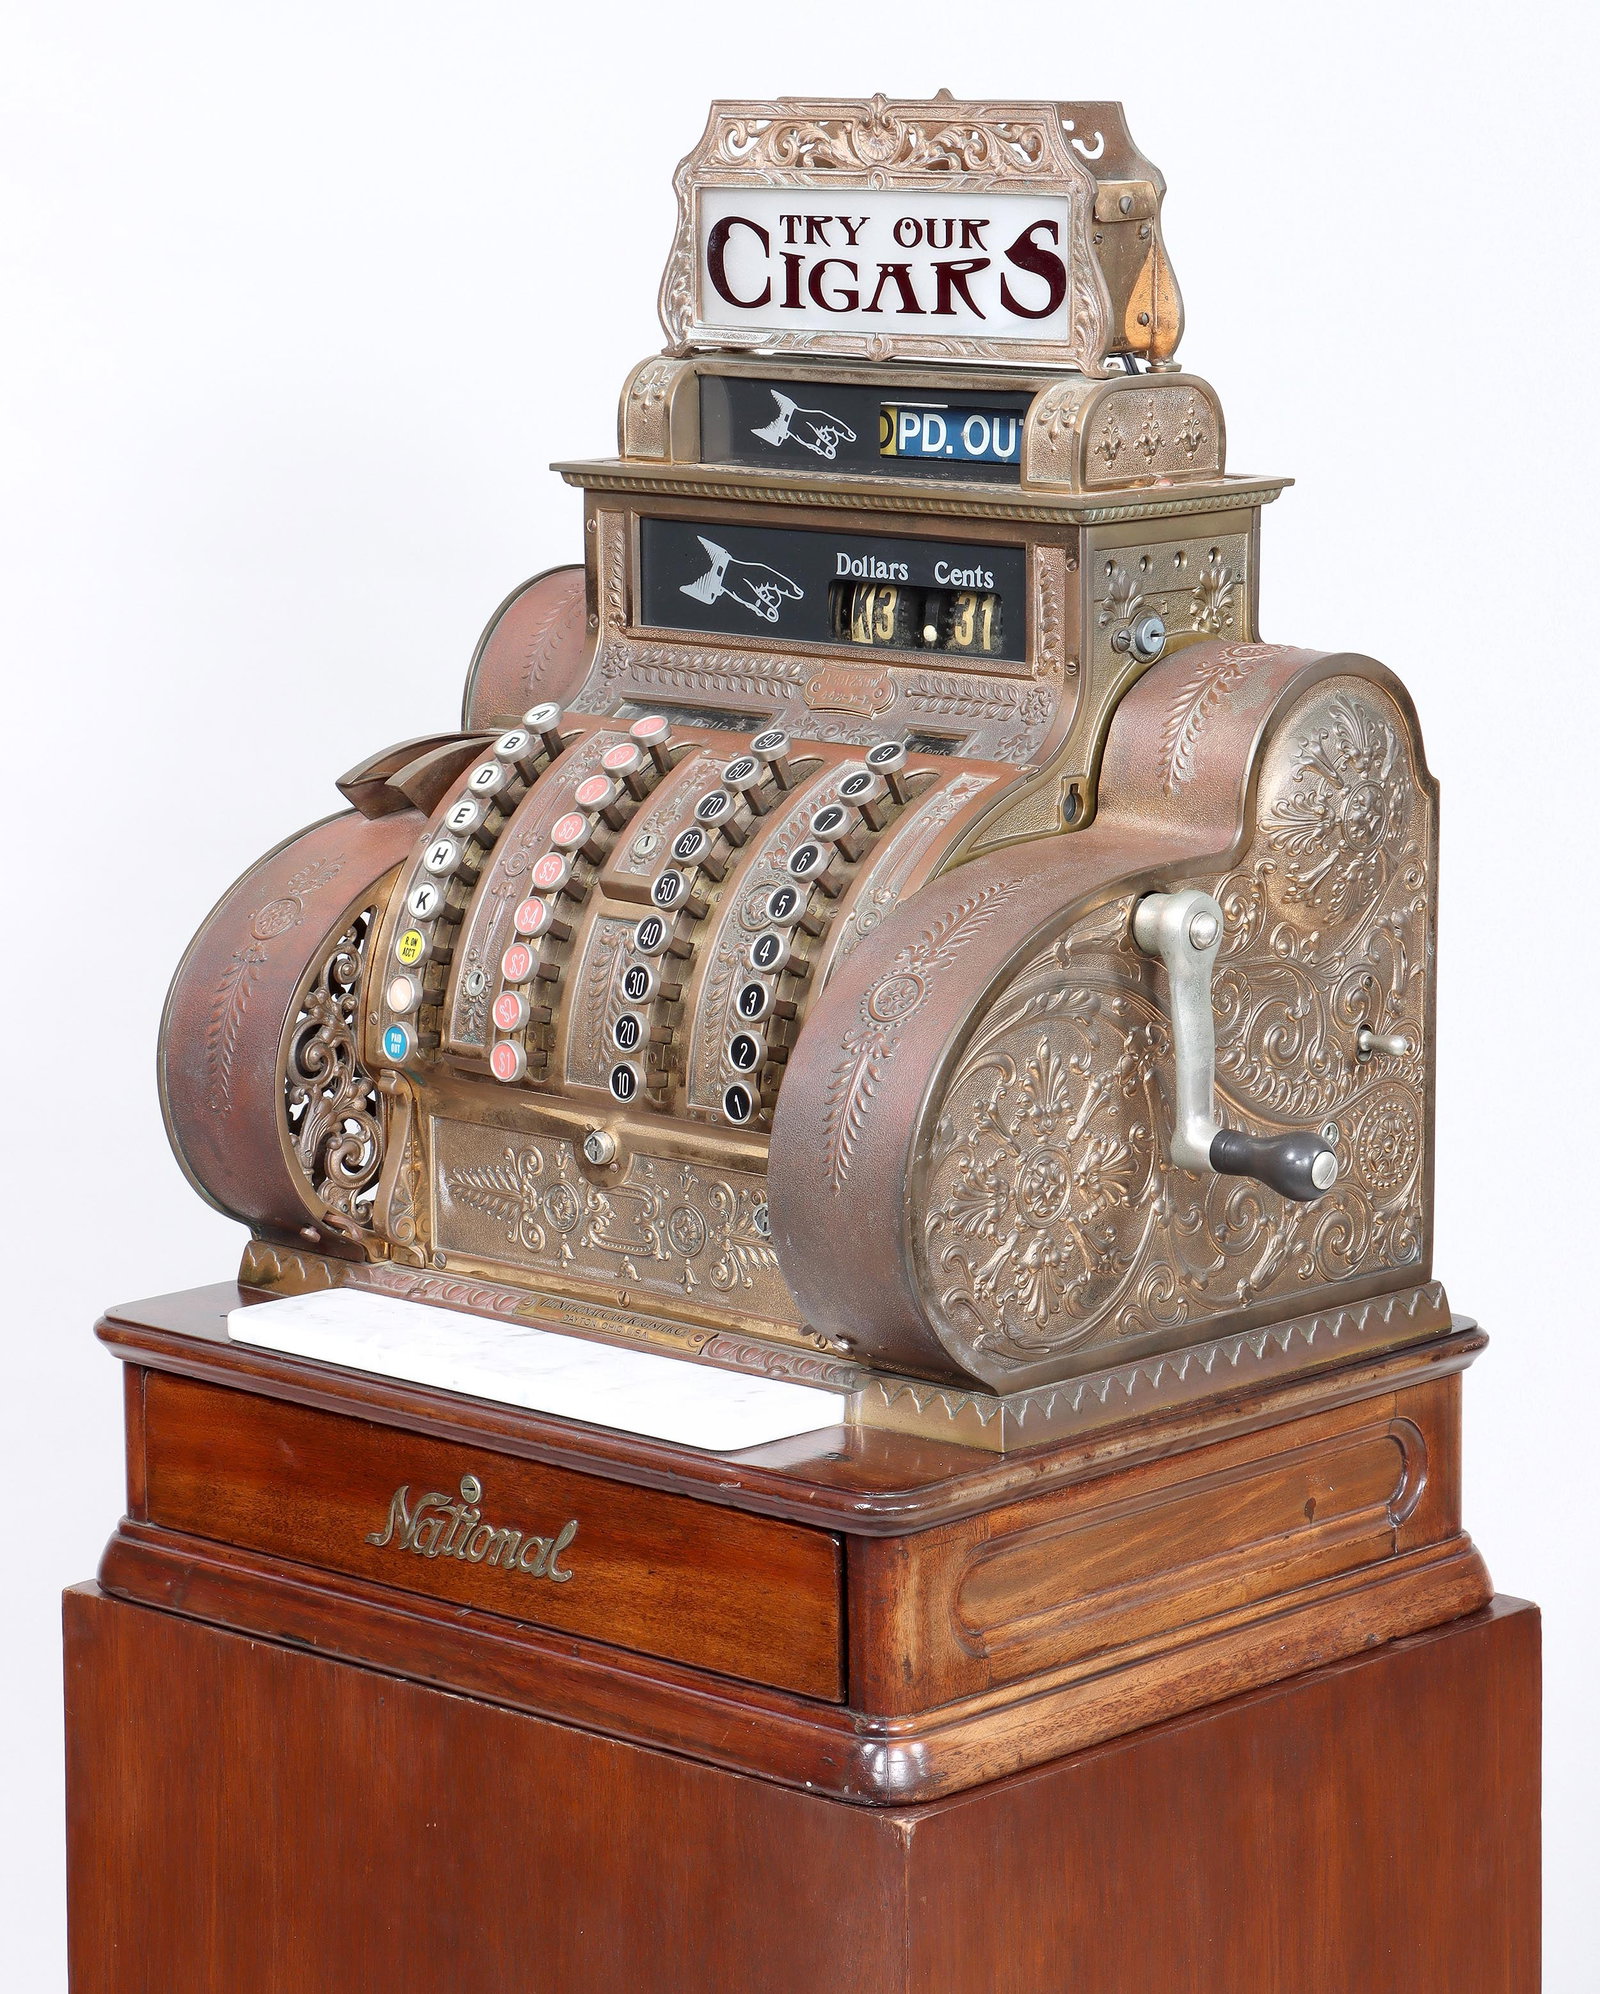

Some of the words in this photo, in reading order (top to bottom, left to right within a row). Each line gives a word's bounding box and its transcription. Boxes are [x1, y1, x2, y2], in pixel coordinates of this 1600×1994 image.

[779, 214, 871, 248] TRY
[892, 216, 991, 252] OUR
[706, 215, 1067, 321] CIGARS
[898, 411, 954, 455] PD.
[835, 552, 909, 581] Dollars
[934, 560, 995, 589] Cents
[532, 709, 550, 721] A
[503, 736, 520, 750] B
[758, 733, 783, 747] 90
[877, 747, 894, 761] 9
[476, 769, 494, 785] D
[728, 762, 752, 779] 80
[847, 778, 864, 794] 8
[453, 808, 471, 824] E
[701, 797, 724, 816] 70
[819, 813, 837, 831] 7
[678, 833, 700, 854] 60
[431, 847, 449, 865] H
[796, 851, 812, 872] 6
[415, 891, 431, 911] K
[657, 878, 677, 901] 50
[520, 905, 537, 930] $4
[775, 895, 790, 917] 5
[640, 923, 659, 946] 40
[759, 940, 773, 963] 4
[508, 952, 526, 977] $3
[628, 971, 646, 996] 30
[499, 999, 517, 1024] $2
[746, 990, 757, 1015] 3
[390, 1032, 402, 1043] PAID
[619, 1020, 635, 1045] 20
[390, 1043, 401, 1054] OUT
[738, 1042, 747, 1067] 2
[499, 1052, 512, 1075] $1
[617, 1072, 629, 1097] 10
[734, 1094, 743, 1118] 1
[365, 1485, 578, 1583] National
